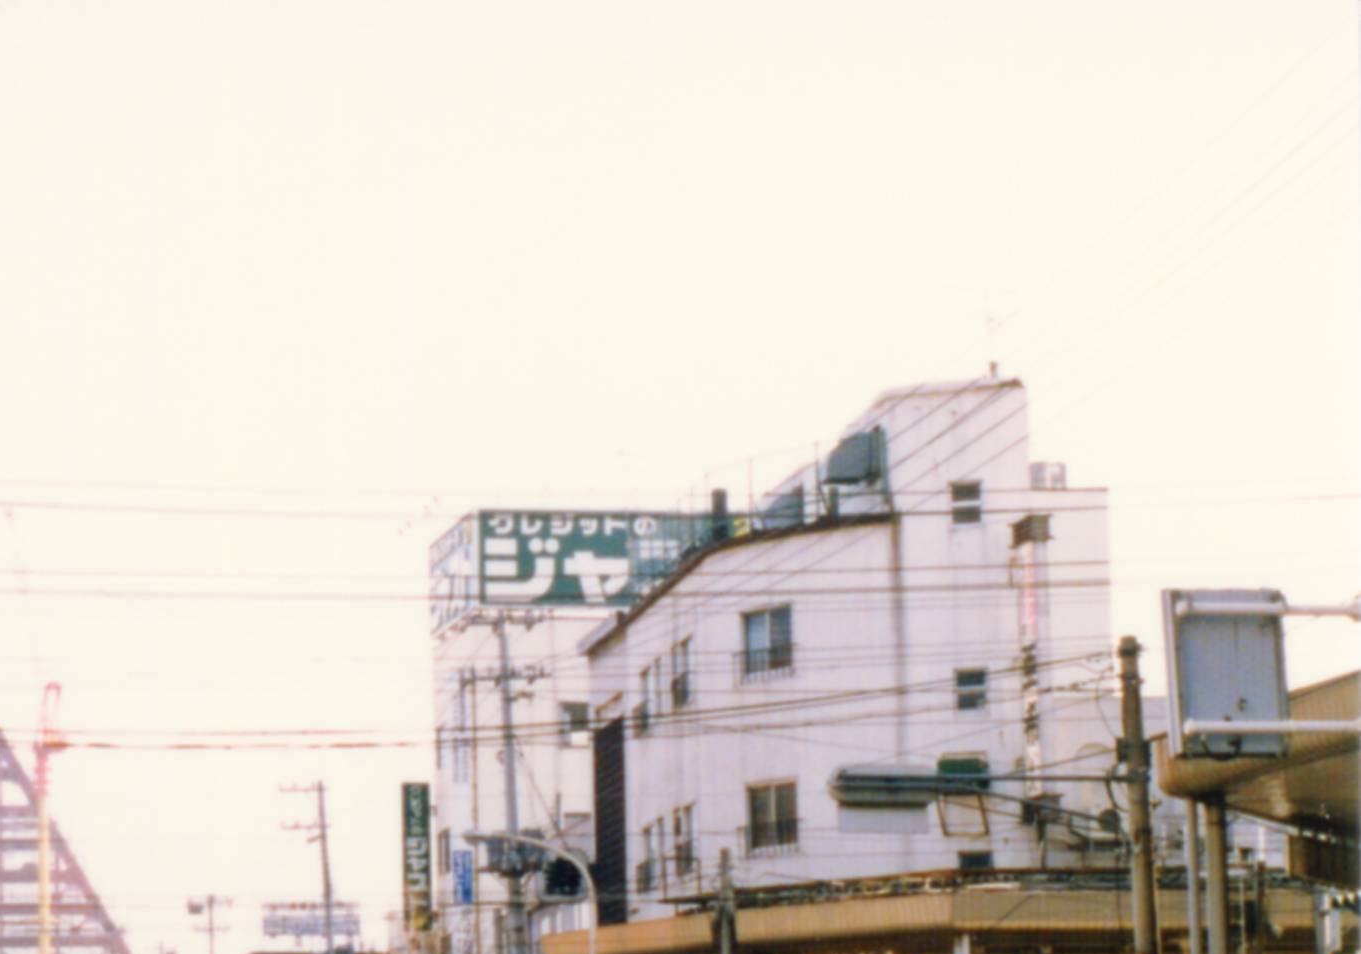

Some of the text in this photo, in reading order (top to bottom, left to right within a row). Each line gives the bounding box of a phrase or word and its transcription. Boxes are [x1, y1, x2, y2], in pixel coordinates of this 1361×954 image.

[487, 513, 658, 536] クレジットの
